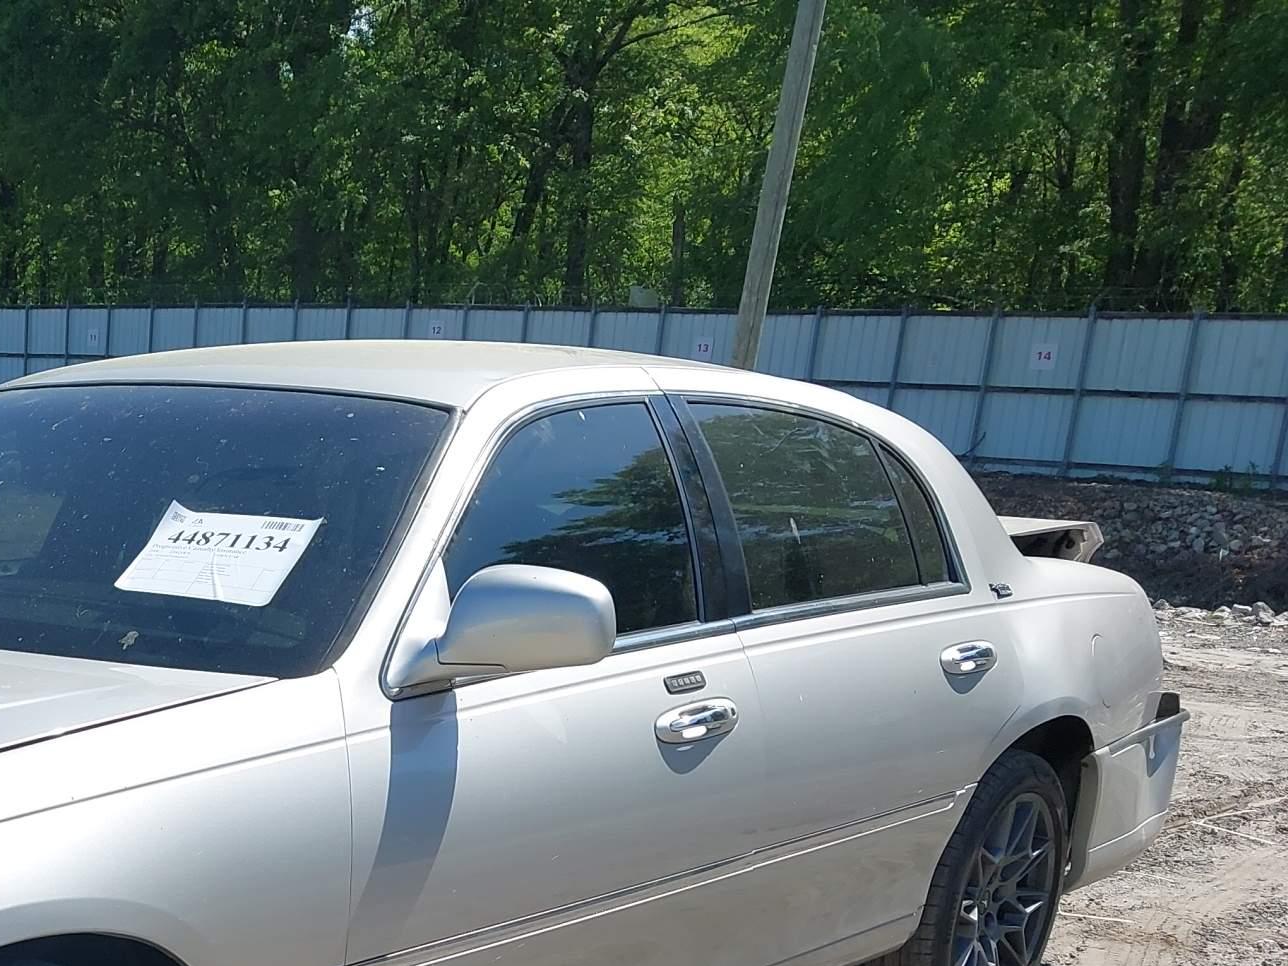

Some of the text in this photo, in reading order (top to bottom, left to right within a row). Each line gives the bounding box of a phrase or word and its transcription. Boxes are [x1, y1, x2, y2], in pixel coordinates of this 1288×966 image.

[431, 325, 442, 336] 12
[697, 343, 710, 353] 13
[1037, 351, 1052, 361] 14
[167, 530, 291, 552] 44871134
